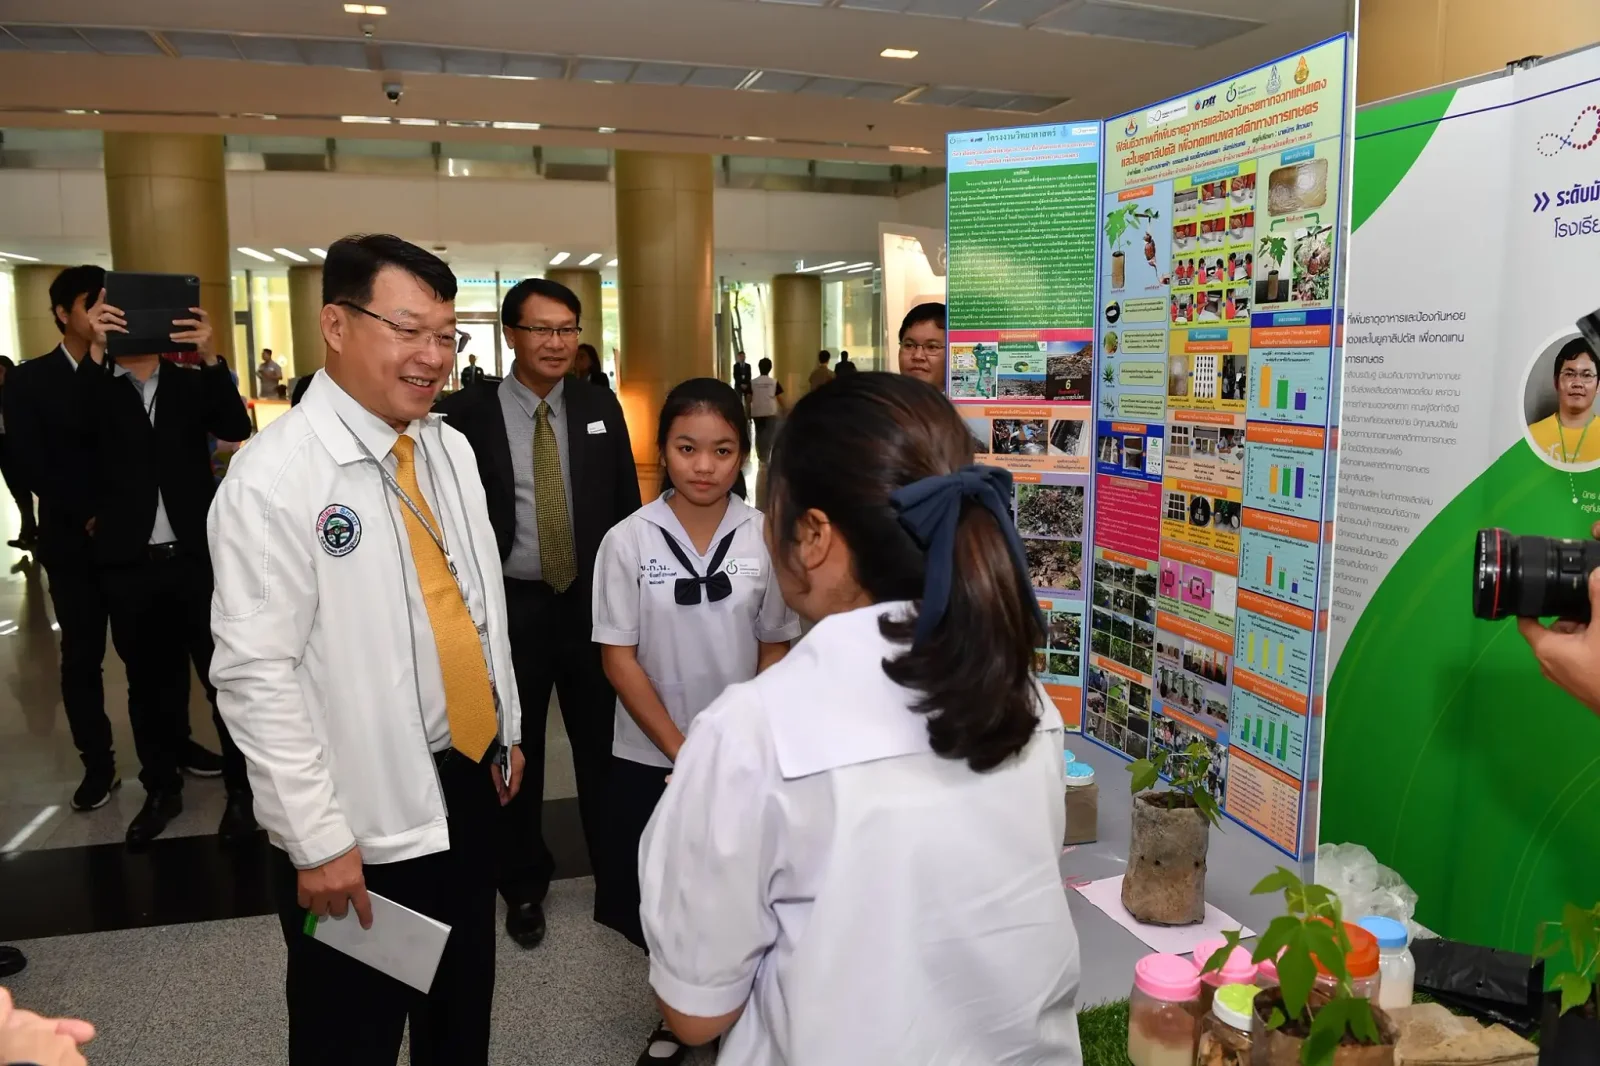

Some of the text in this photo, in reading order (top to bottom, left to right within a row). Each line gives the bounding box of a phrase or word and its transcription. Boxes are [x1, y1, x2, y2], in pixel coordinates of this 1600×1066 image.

[1202, 95, 1216, 109] ptt
[987, 127, 1056, 142] โครงงานวิทยาศาสตร์
[1418, 330, 1464, 344] เพื่อทดแทน
[1066, 379, 1071, 390] 6
[316, 506, 358, 532] Thailand Smart
